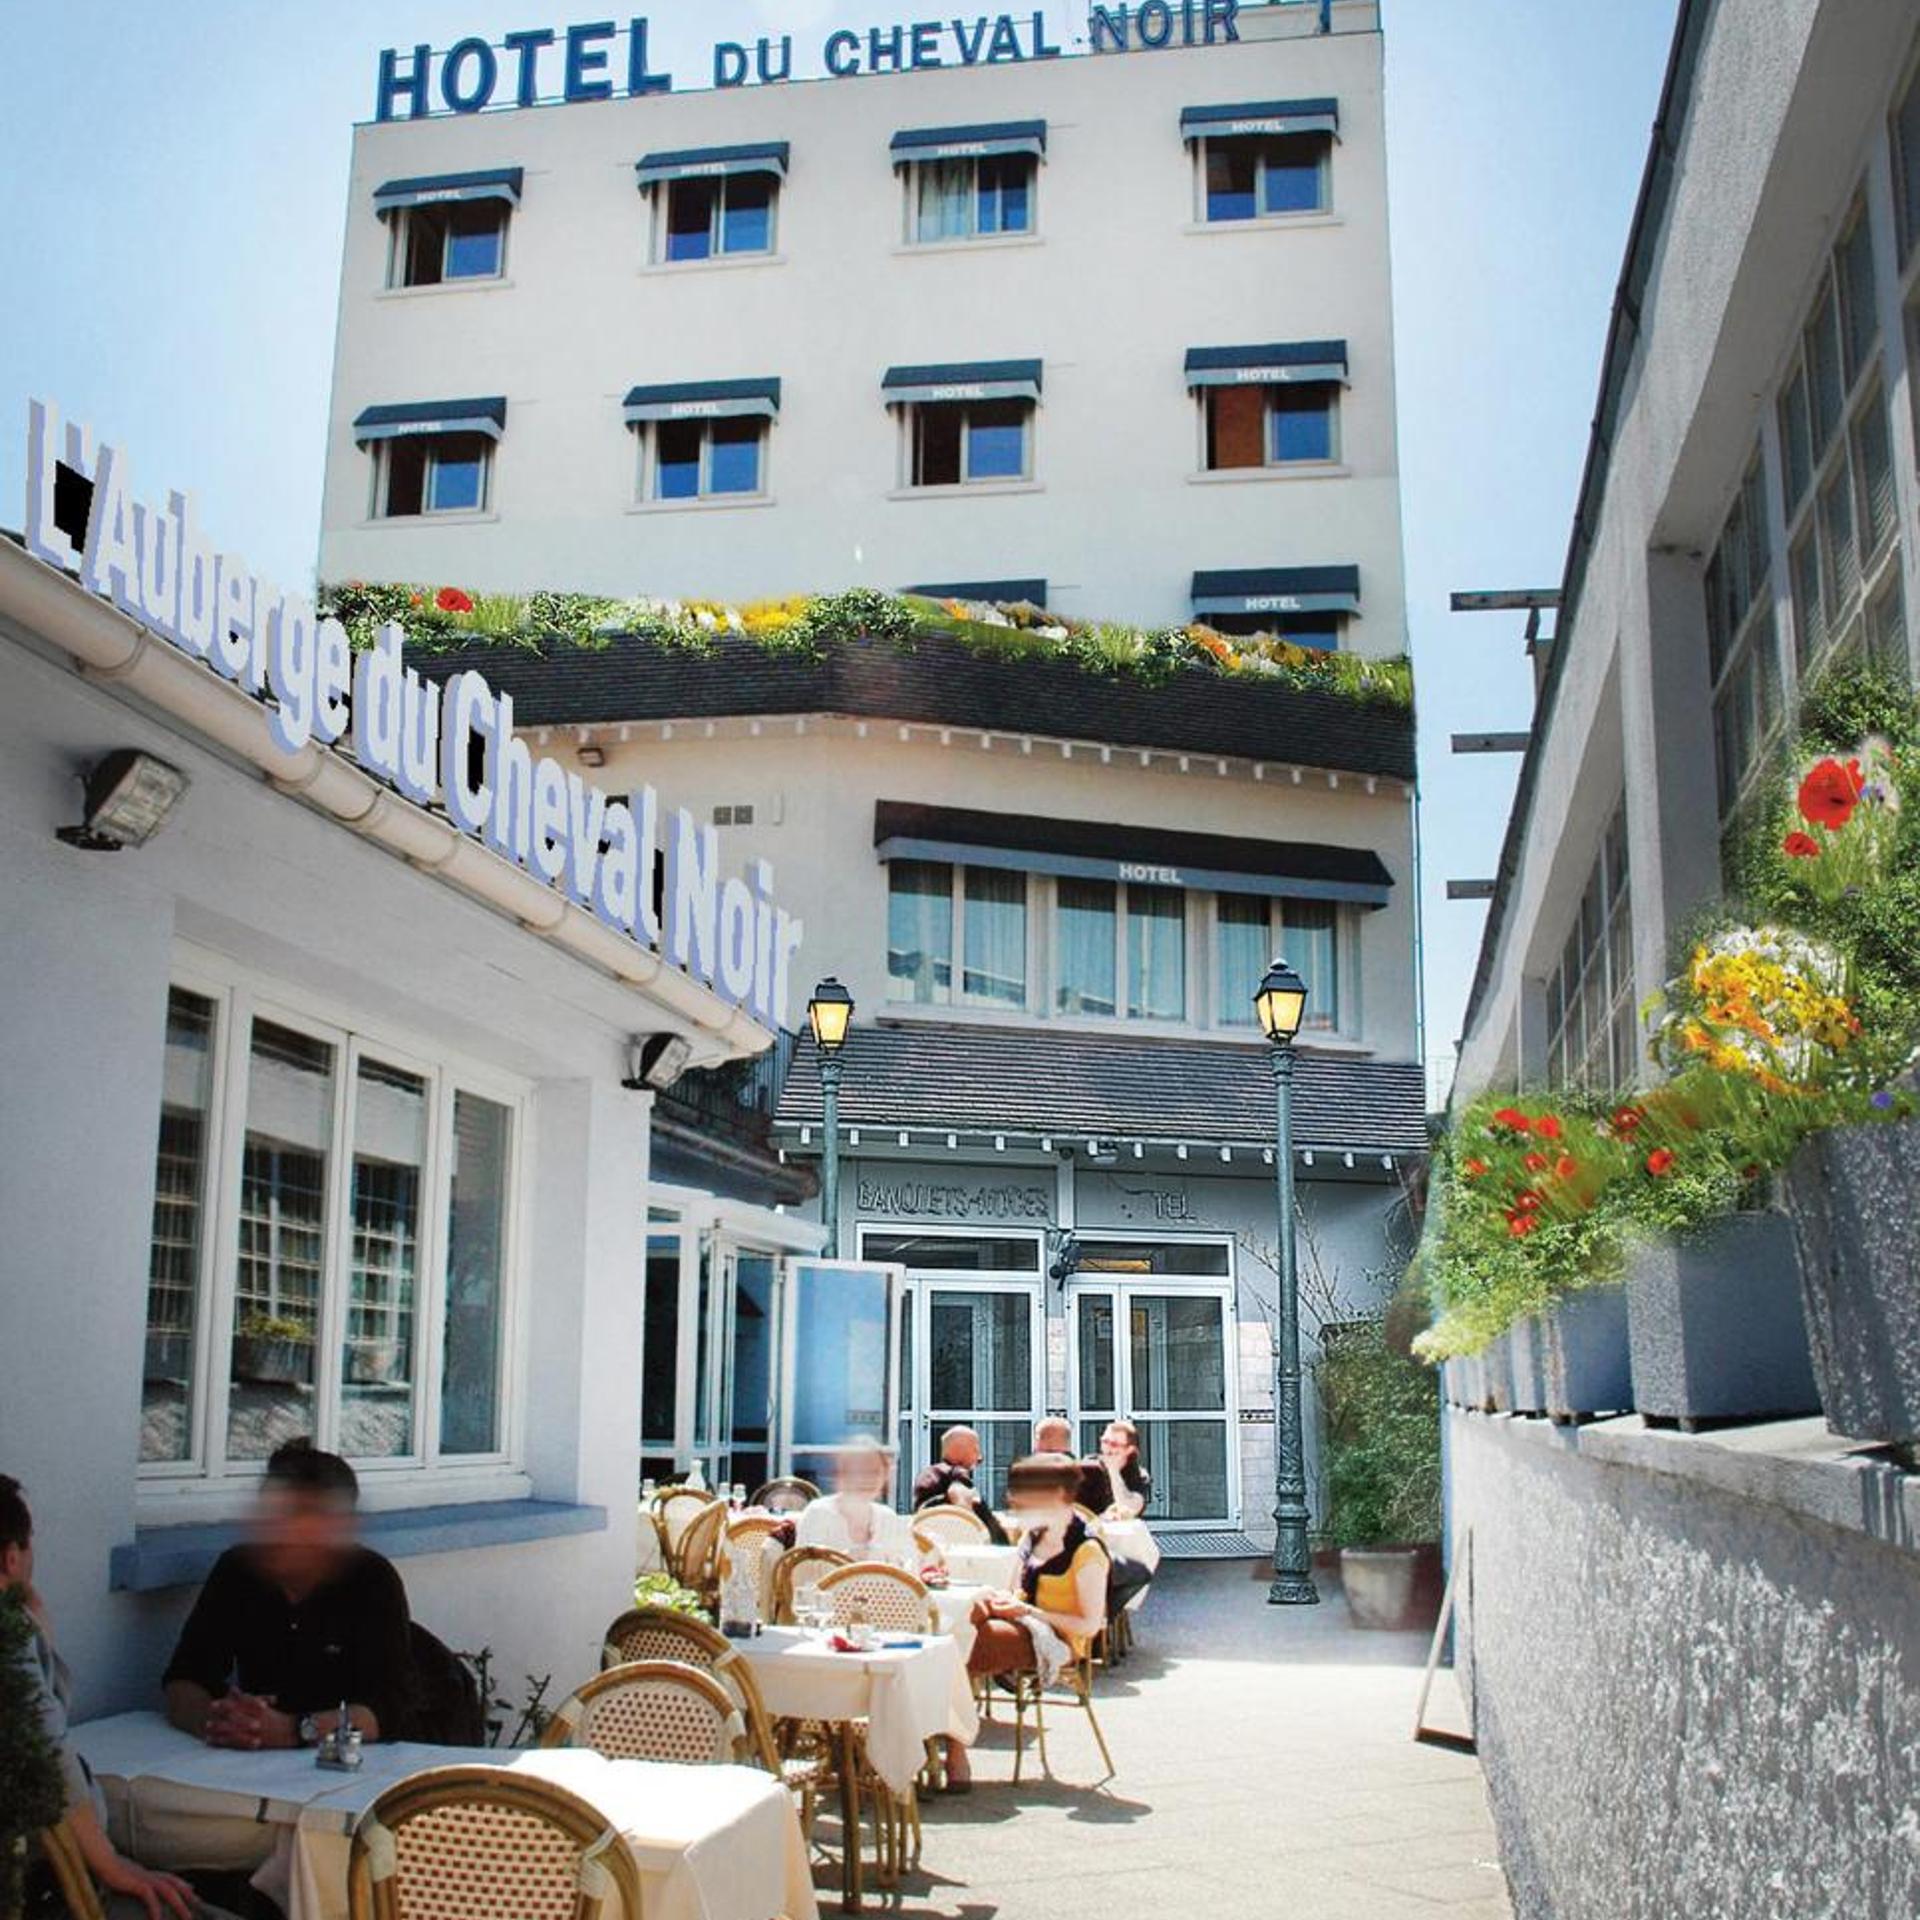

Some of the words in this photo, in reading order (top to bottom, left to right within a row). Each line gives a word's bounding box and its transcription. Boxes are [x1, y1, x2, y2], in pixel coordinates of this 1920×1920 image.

[374, 17, 672, 122] HOTEL
[713, 36, 791, 88] DU
[824, 11, 1061, 76] CHEVAL
[1090, 0, 1239, 51] NOIR
[1232, 119, 1285, 133] HOTEL
[1237, 367, 1290, 381] HOTEL
[932, 385, 984, 399] HOTEL
[1245, 597, 1300, 611] HOTEL
[26, 396, 351, 756] L'Auberge
[352, 620, 439, 801] du
[441, 669, 661, 953] Cheval
[662, 805, 803, 1032] Noir
[1119, 862, 1182, 885] HOTEL
